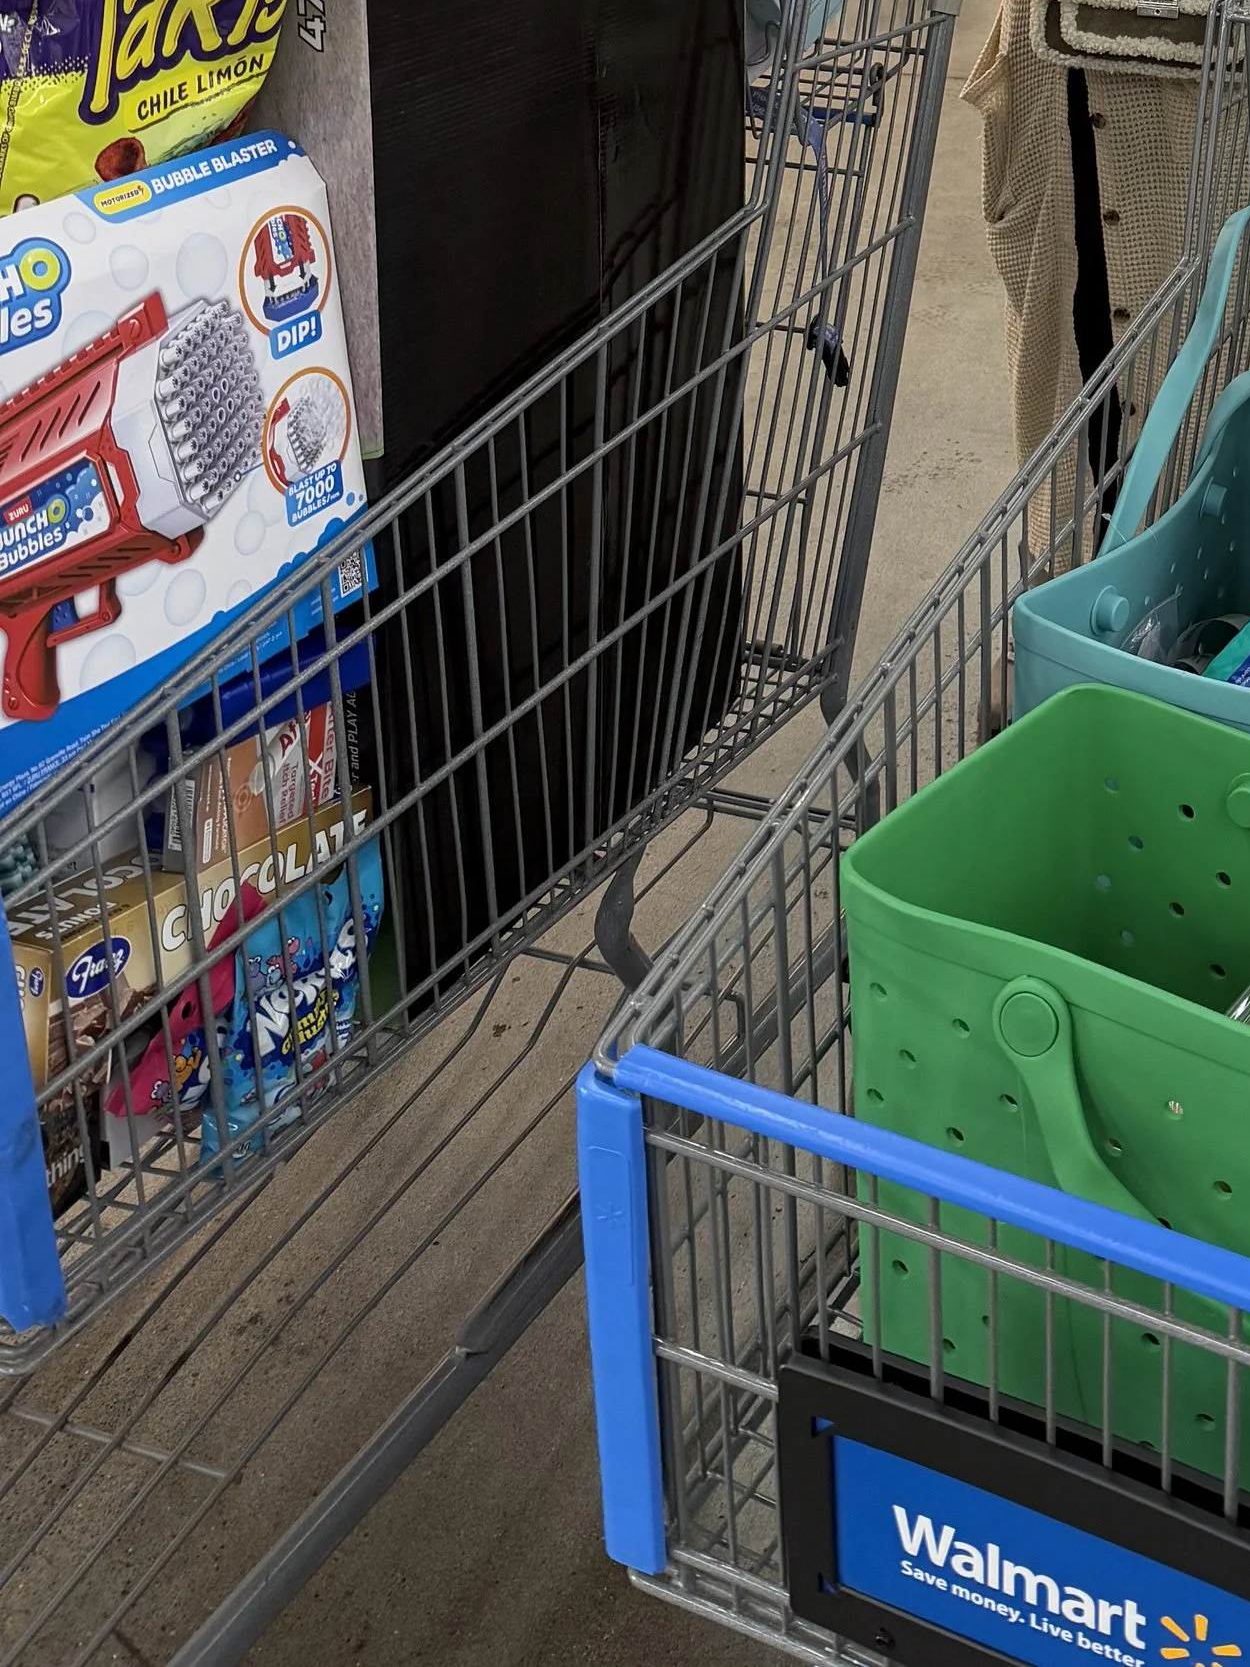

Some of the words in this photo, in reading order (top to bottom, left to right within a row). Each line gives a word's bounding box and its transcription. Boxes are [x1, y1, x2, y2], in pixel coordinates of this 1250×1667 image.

[137, 82, 189, 121] CHILE
[197, 53, 265, 94] LIMÓN
[101, 188, 140, 207] MOTORIZED
[151, 161, 212, 194] BUBBLE
[212, 139, 278, 168] BLASTER
[277, 316, 317, 353] DIP!
[289, 473, 314, 495] BLAST
[314, 468, 325, 484] UP
[326, 462, 338, 478] TO
[295, 477, 335, 510] 7000
[9, 504, 29, 521] ZURU
[348, 711, 359, 747] PLAY
[282, 763, 291, 788] Itch
[350, 750, 360, 771] and
[287, 762, 299, 819] Targeted
[321, 759, 335, 800] Bite
[278, 787, 288, 825] Relief
[892, 1504, 1147, 1651] Walmart
[901, 1559, 948, 1593] Save
[951, 1580, 1026, 1626] money.
[1029, 1611, 1074, 1644] Live
[1076, 1628, 1146, 1667] better
